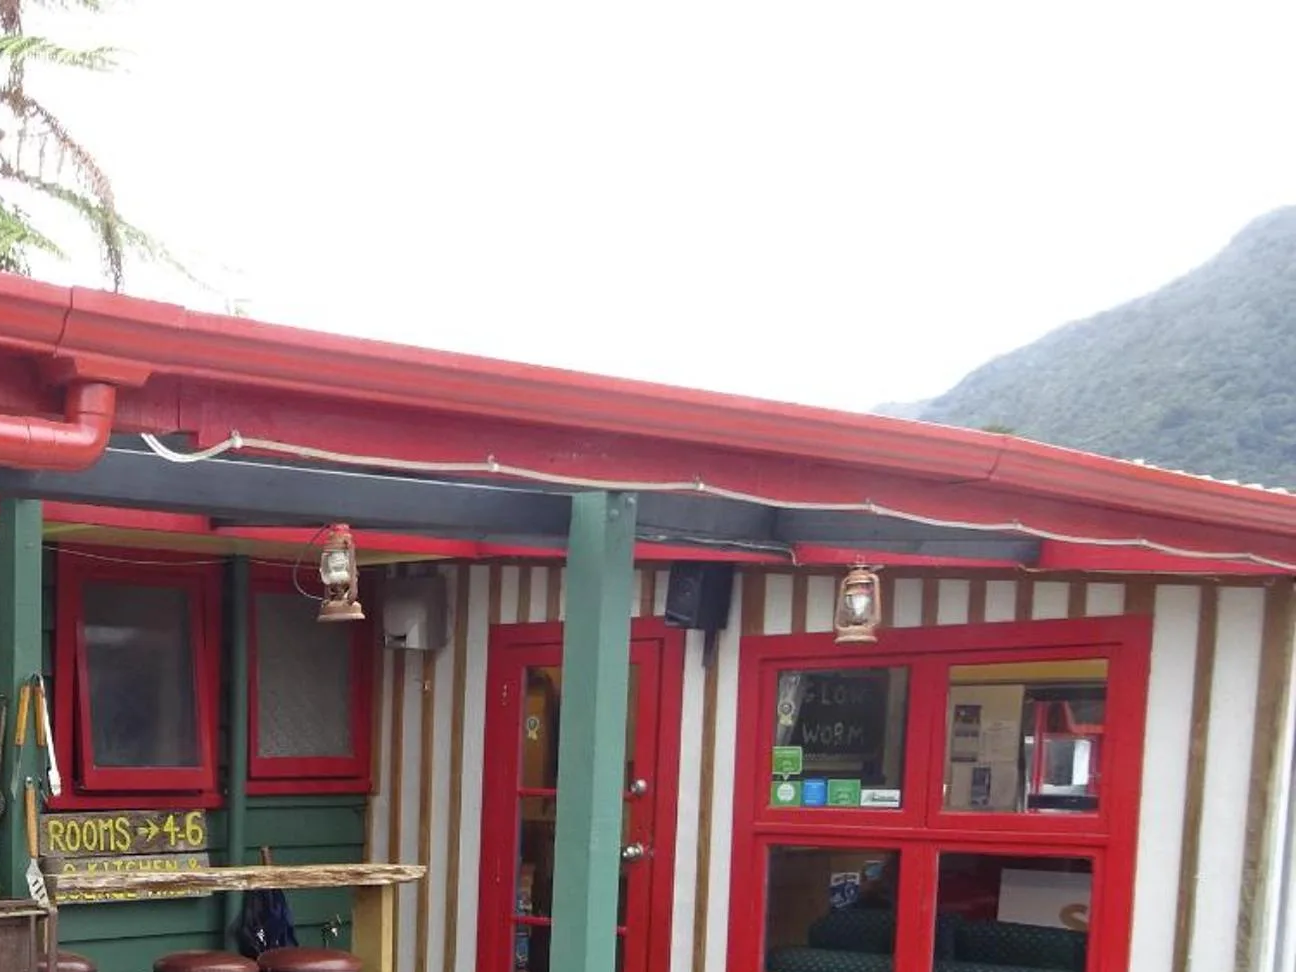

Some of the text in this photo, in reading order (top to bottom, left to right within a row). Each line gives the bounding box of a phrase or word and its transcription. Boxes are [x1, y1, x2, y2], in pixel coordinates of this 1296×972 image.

[802, 721, 864, 746] WORM
[48, 811, 203, 851] ROOMS 4-6
